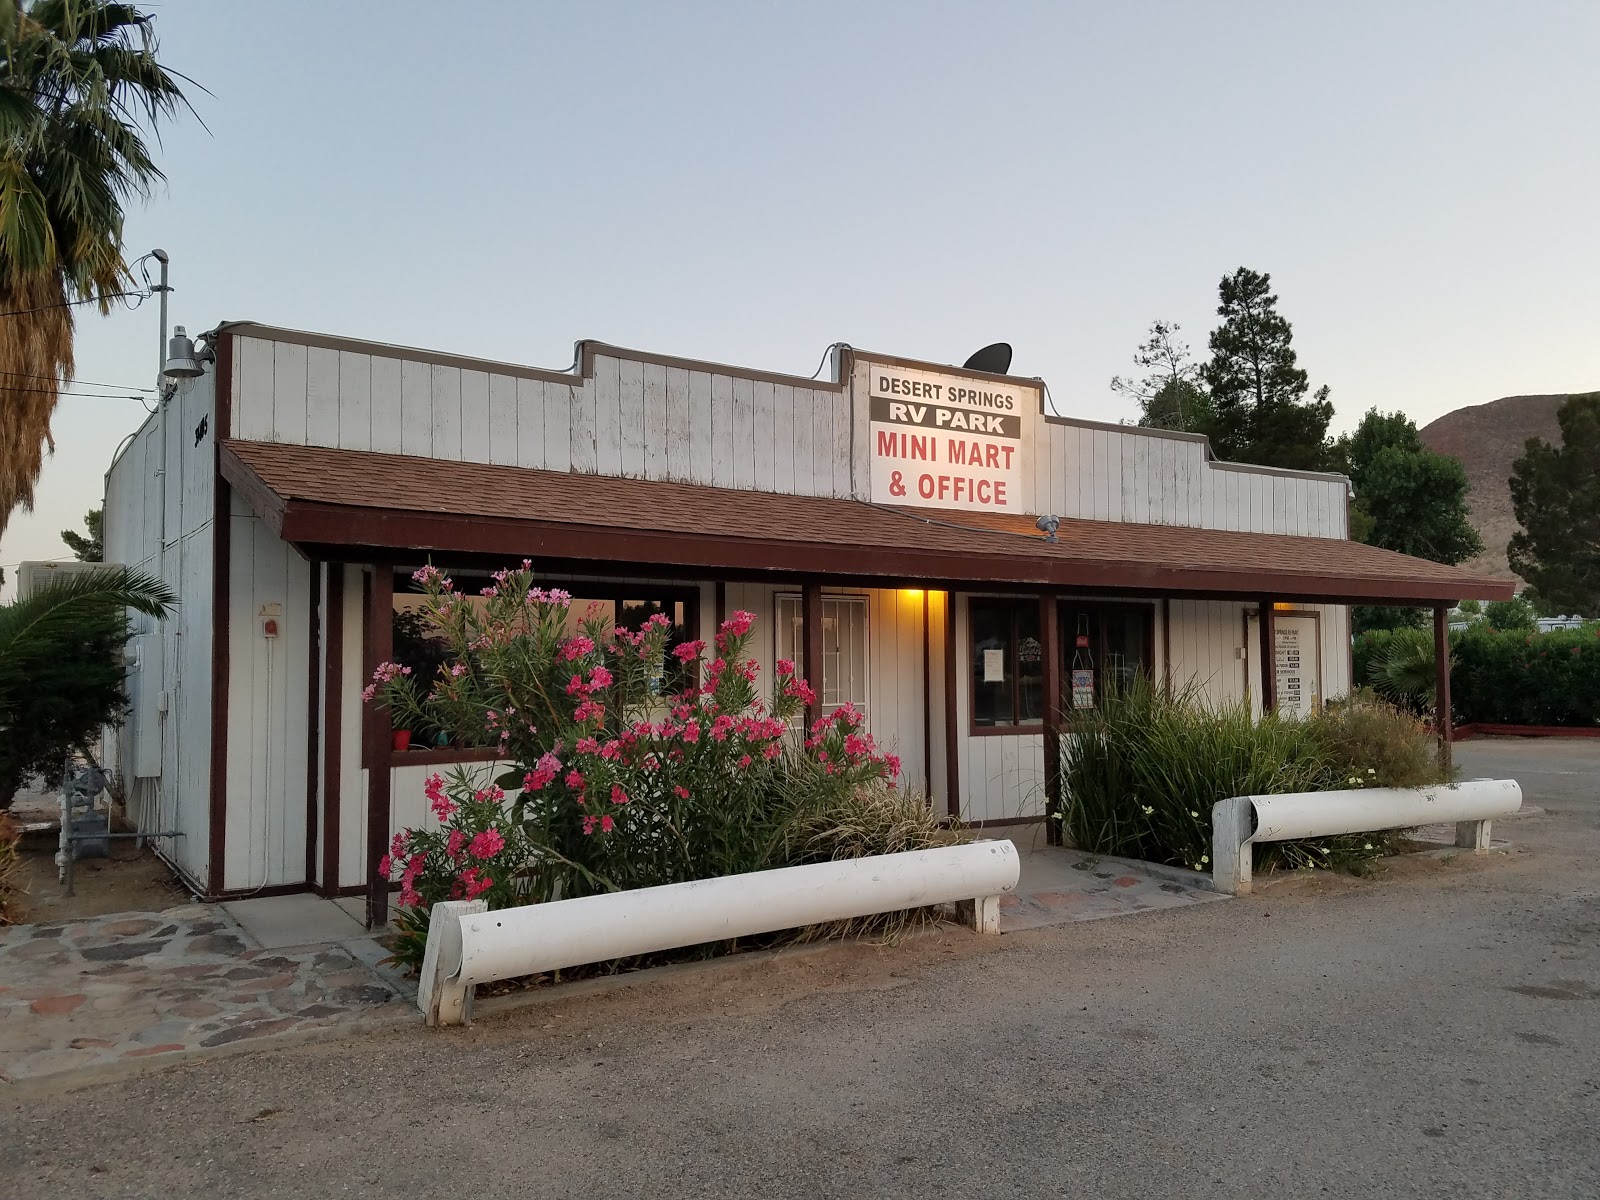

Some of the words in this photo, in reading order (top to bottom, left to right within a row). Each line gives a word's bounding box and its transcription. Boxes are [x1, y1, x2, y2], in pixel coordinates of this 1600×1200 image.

[879, 376, 942, 400] DESERT
[948, 386, 1014, 410] SPRINGS
[889, 402, 927, 424] RV
[935, 408, 1005, 435] PARK
[877, 431, 937, 462] MINI
[948, 438, 1015, 470] MART
[889, 470, 907, 497] &
[918, 473, 1007, 506] OFFICE
